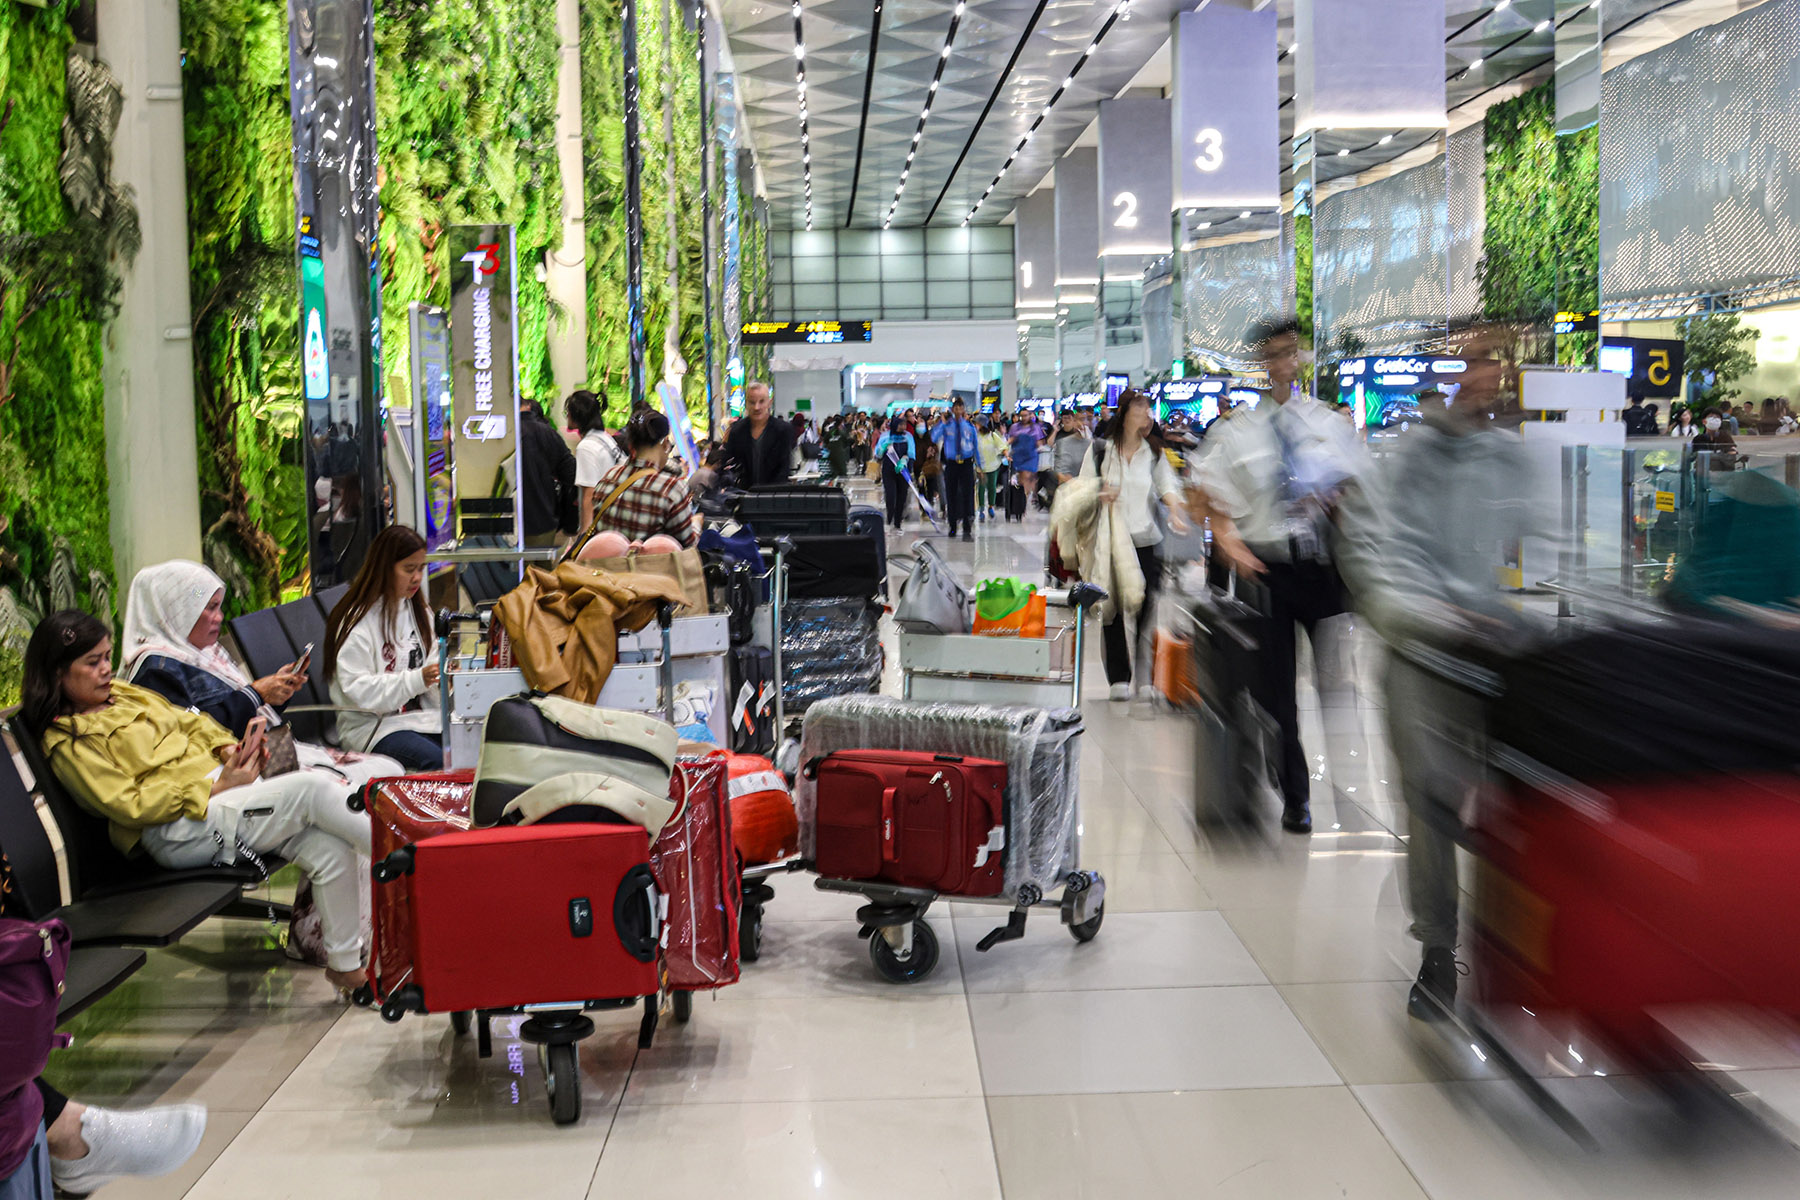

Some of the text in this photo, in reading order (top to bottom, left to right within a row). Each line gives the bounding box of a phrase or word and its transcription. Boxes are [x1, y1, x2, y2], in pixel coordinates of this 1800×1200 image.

[1195, 128, 1223, 171] 3
[1113, 192, 1138, 228] 2
[460, 243, 501, 285] T3
[1020, 261, 1032, 288] 1
[473, 287, 493, 411] FREE CHARGING
[1373, 357, 1429, 374] GrabCar
